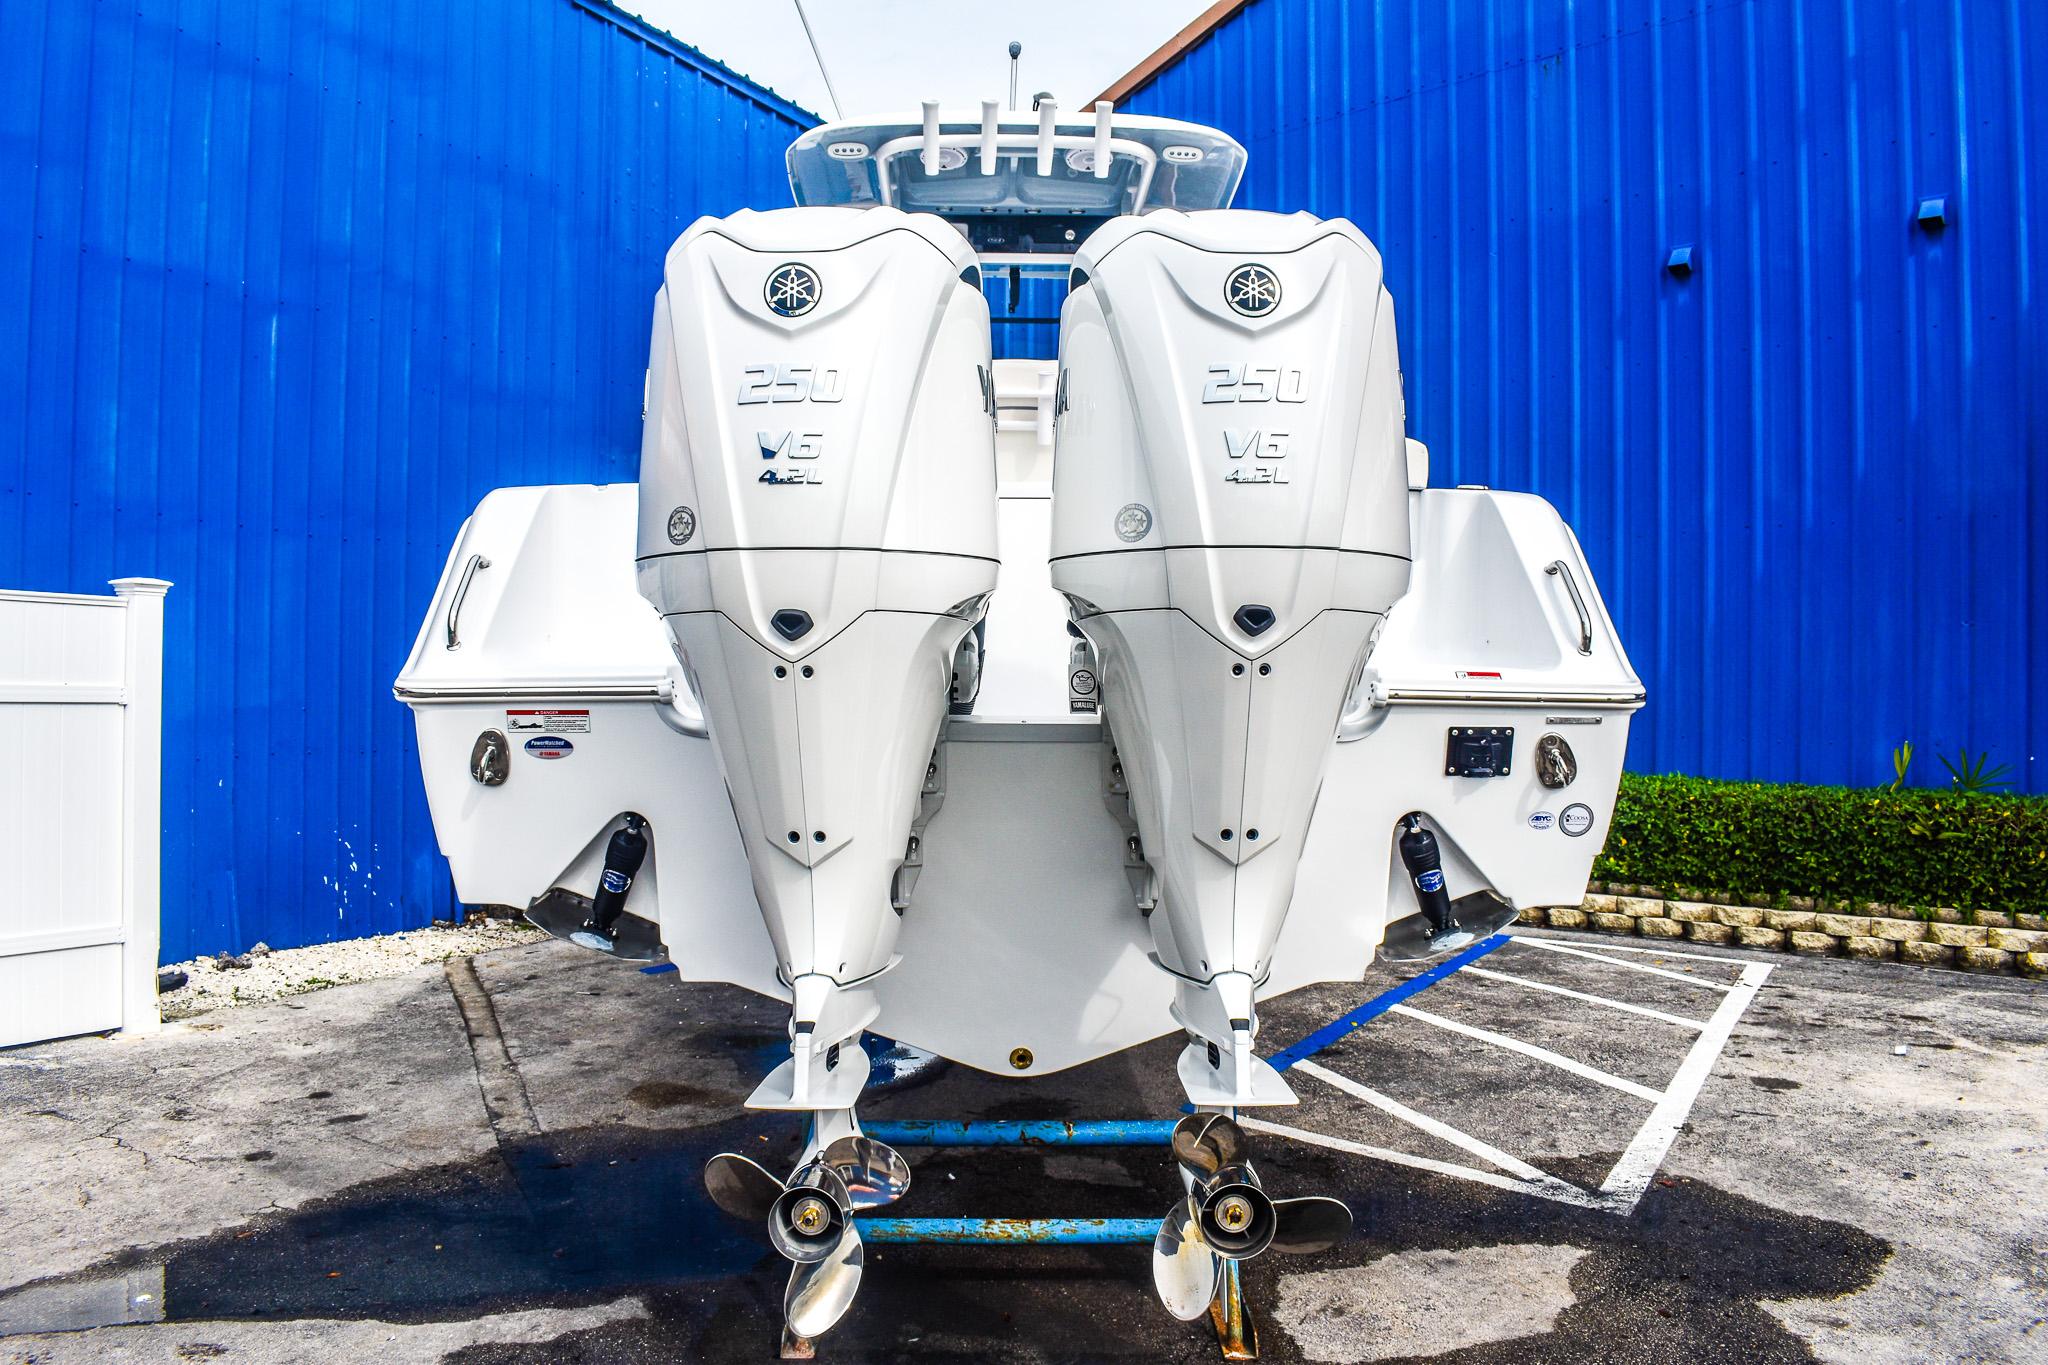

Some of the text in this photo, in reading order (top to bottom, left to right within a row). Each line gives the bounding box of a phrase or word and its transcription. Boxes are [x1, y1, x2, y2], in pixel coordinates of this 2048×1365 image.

[738, 364, 848, 405] 250
[1202, 363, 1310, 404] 250
[757, 430, 824, 460] V6
[1224, 429, 1290, 459] V6
